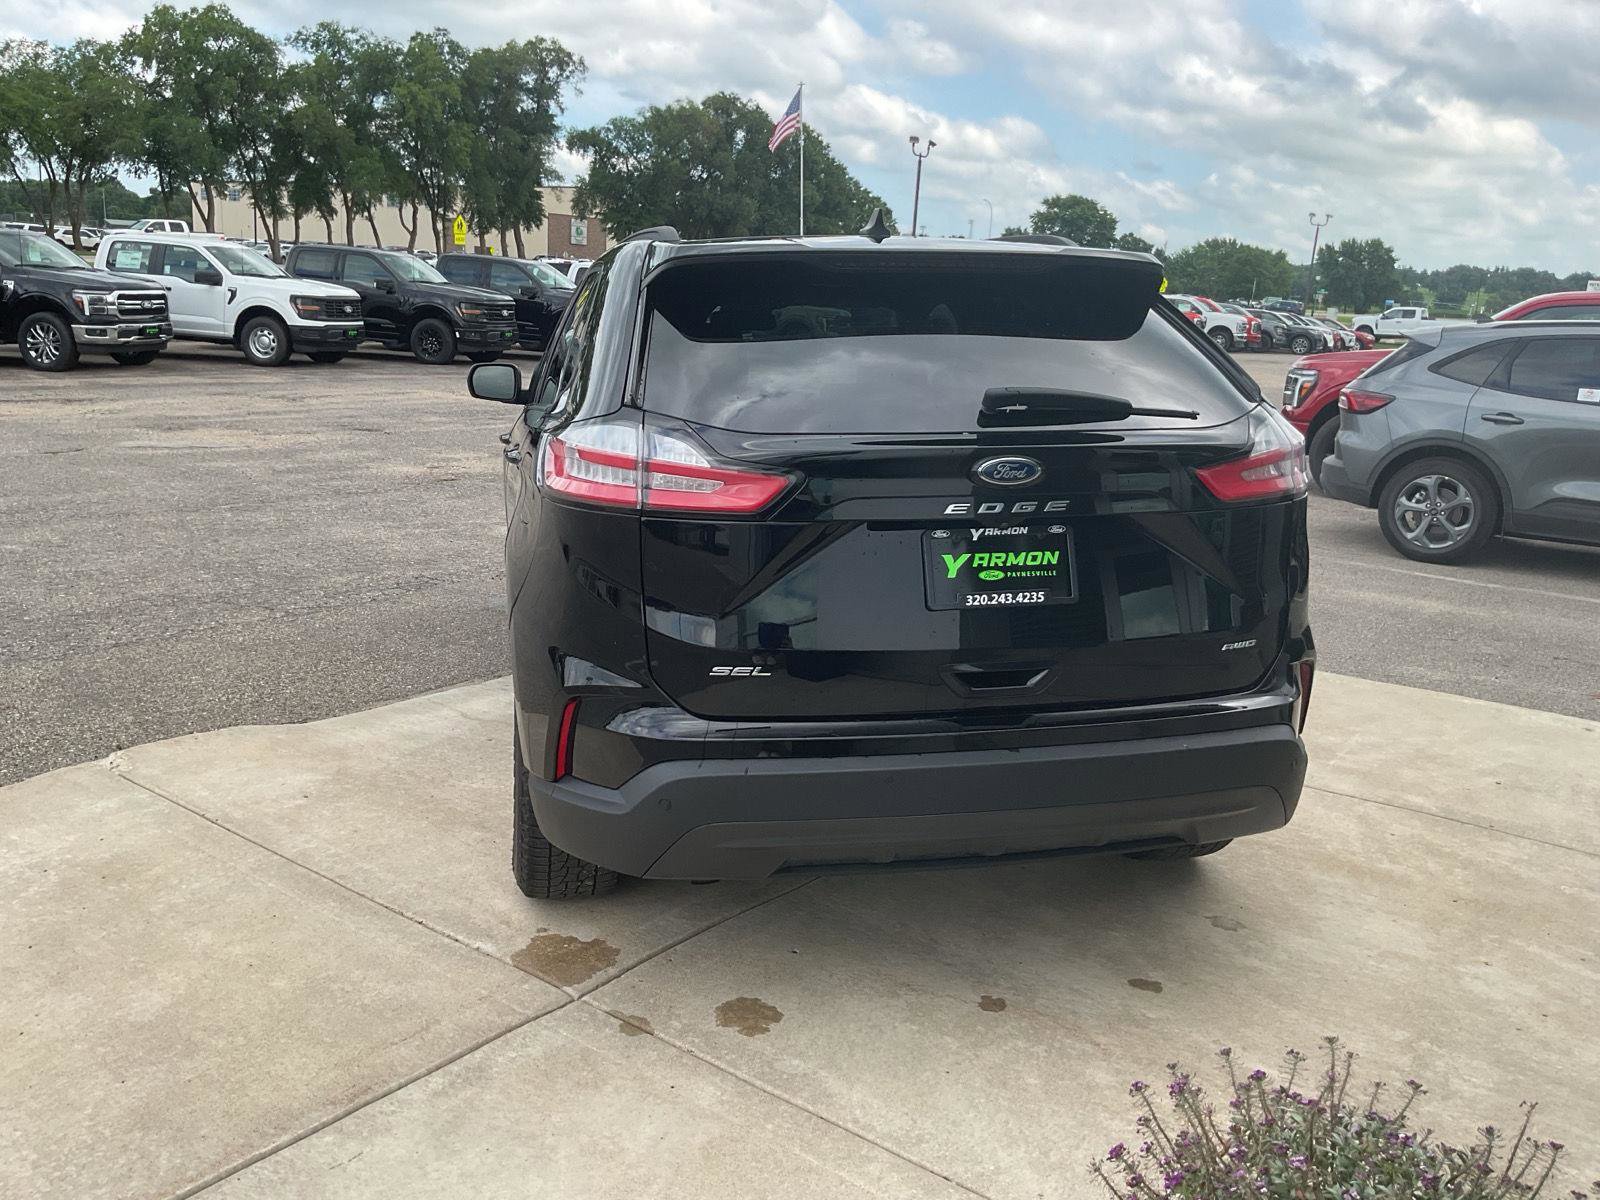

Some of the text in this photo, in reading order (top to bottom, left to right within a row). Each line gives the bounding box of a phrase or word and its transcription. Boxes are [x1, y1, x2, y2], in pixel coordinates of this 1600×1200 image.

[993, 463, 1027, 479] Ford
[943, 500, 1070, 515] EDGE
[970, 526, 1029, 541] YARMON
[941, 551, 1060, 579] YARMON
[965, 591, 1045, 606] 320.243.4235
[1221, 639, 1257, 651] AWD
[708, 666, 772, 676] SEL
